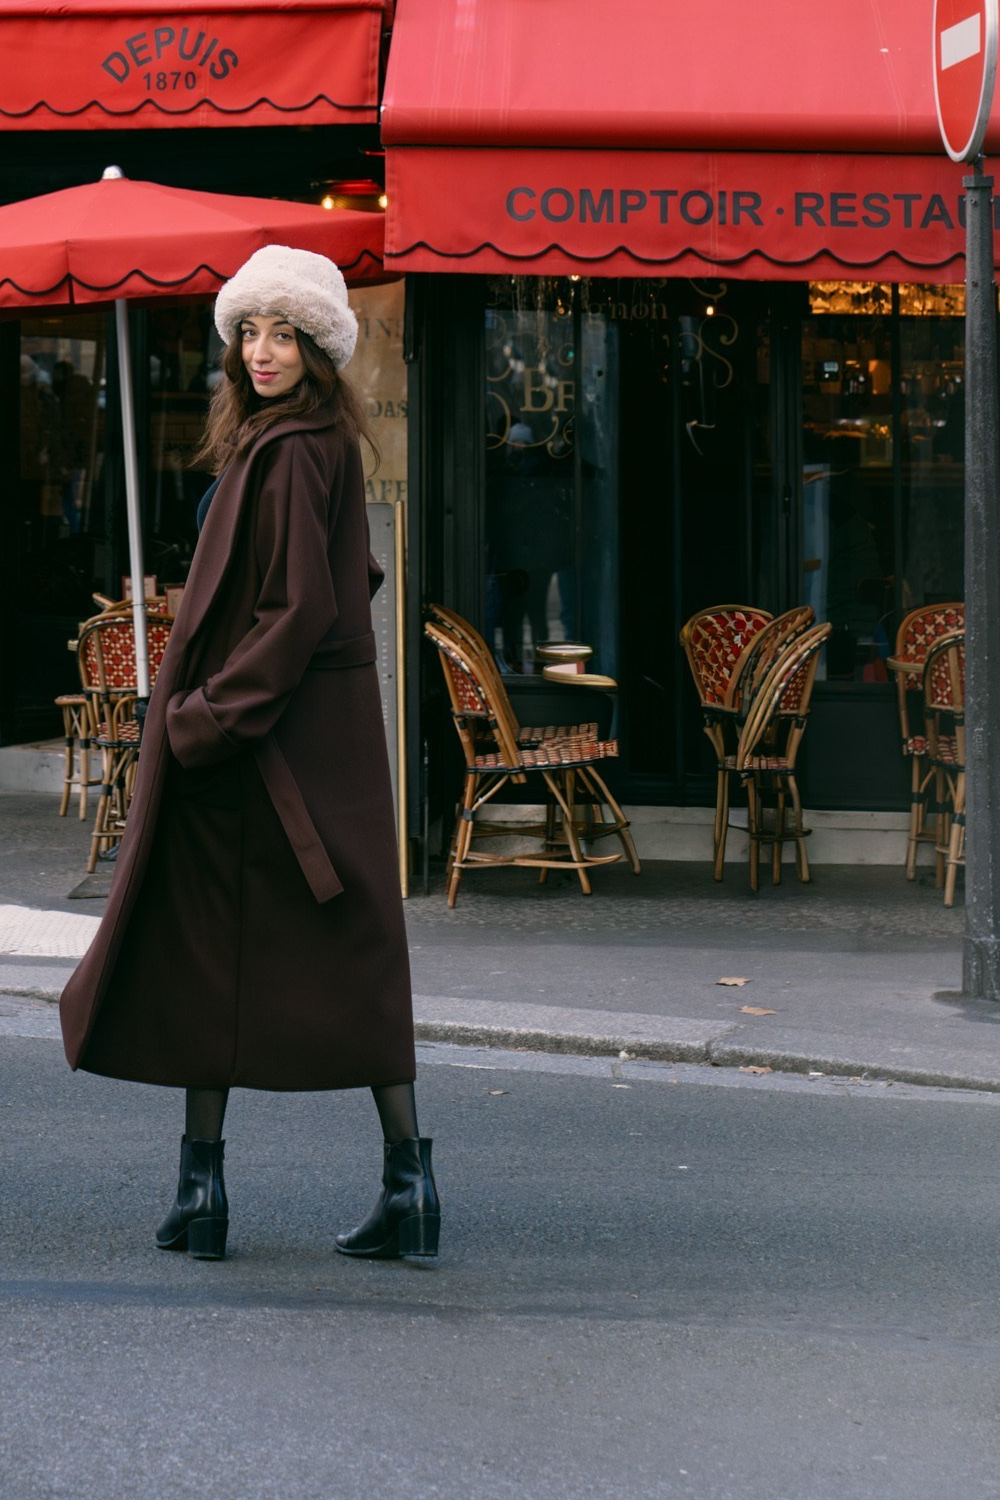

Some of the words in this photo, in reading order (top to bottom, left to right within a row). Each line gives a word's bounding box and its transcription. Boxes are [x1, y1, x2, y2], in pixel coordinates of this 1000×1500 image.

[101, 26, 238, 84] DEPUIS
[142, 71, 197, 90] 1870
[505, 187, 764, 226] COMPTOIR
